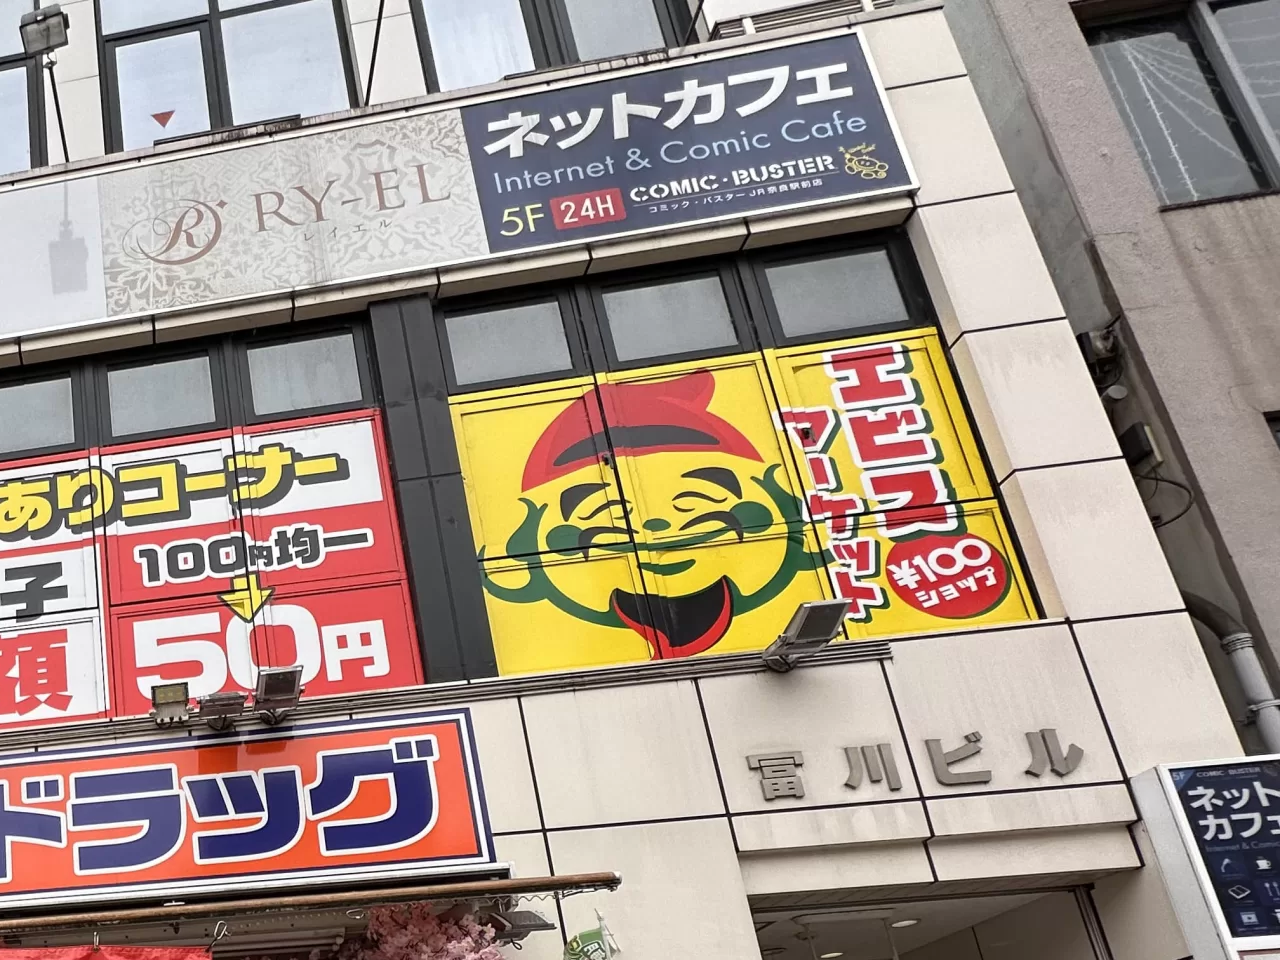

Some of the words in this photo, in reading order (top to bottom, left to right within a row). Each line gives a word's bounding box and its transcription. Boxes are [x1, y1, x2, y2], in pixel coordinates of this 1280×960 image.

[483, 62, 854, 159] ネットカフェ
[494, 156, 615, 195] Internet
[625, 148, 652, 171] &
[660, 128, 771, 164] Comic
[782, 111, 868, 145] Cafe
[254, 163, 452, 233] RY-EL
[499, 204, 546, 236] 5F
[560, 194, 615, 224] 24H
[302, 219, 394, 243] レイエル
[134, 526, 375, 587] 100円均一
[887, 537, 992, 590] ¥100
[915, 565, 995, 609] ショップ
[134, 603, 391, 701] 50円
[1187, 781, 1280, 812] ネット
